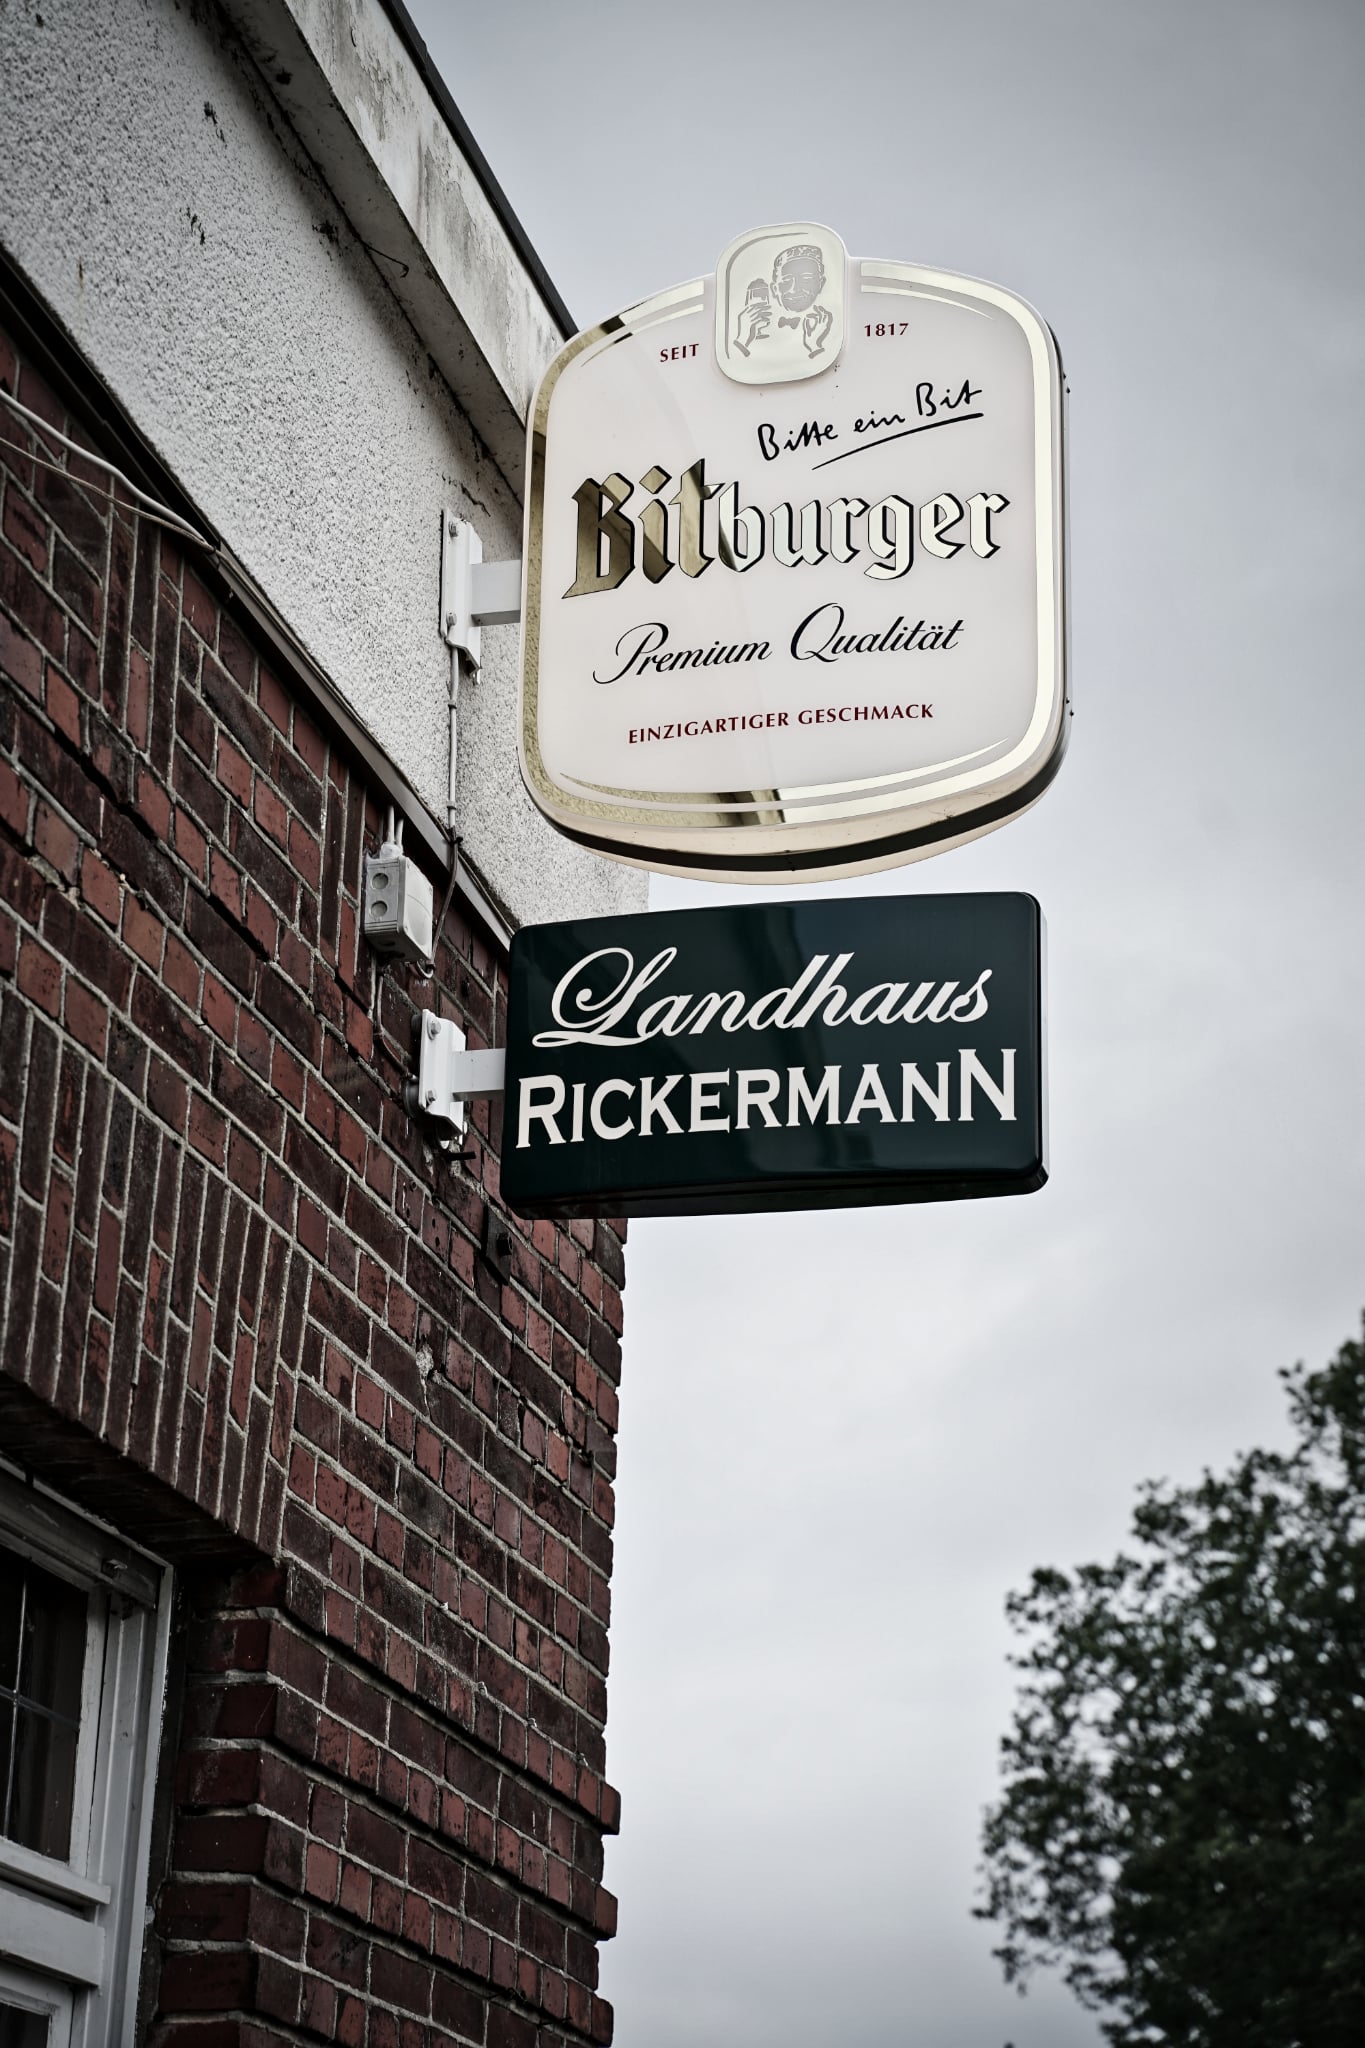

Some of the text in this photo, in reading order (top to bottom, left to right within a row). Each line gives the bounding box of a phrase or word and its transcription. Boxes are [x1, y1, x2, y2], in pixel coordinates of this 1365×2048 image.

[659, 322, 910, 363] SEIT 1817
[757, 379, 983, 461] Bitte ein Bit
[562, 458, 1010, 600] Bitburger
[592, 602, 965, 685] Premium Qualität
[628, 703, 935, 744] EINZIGARTIGER GESCHMACK
[532, 946, 993, 1048] Landhaus
[515, 1048, 1018, 1149] RICKERMANN
